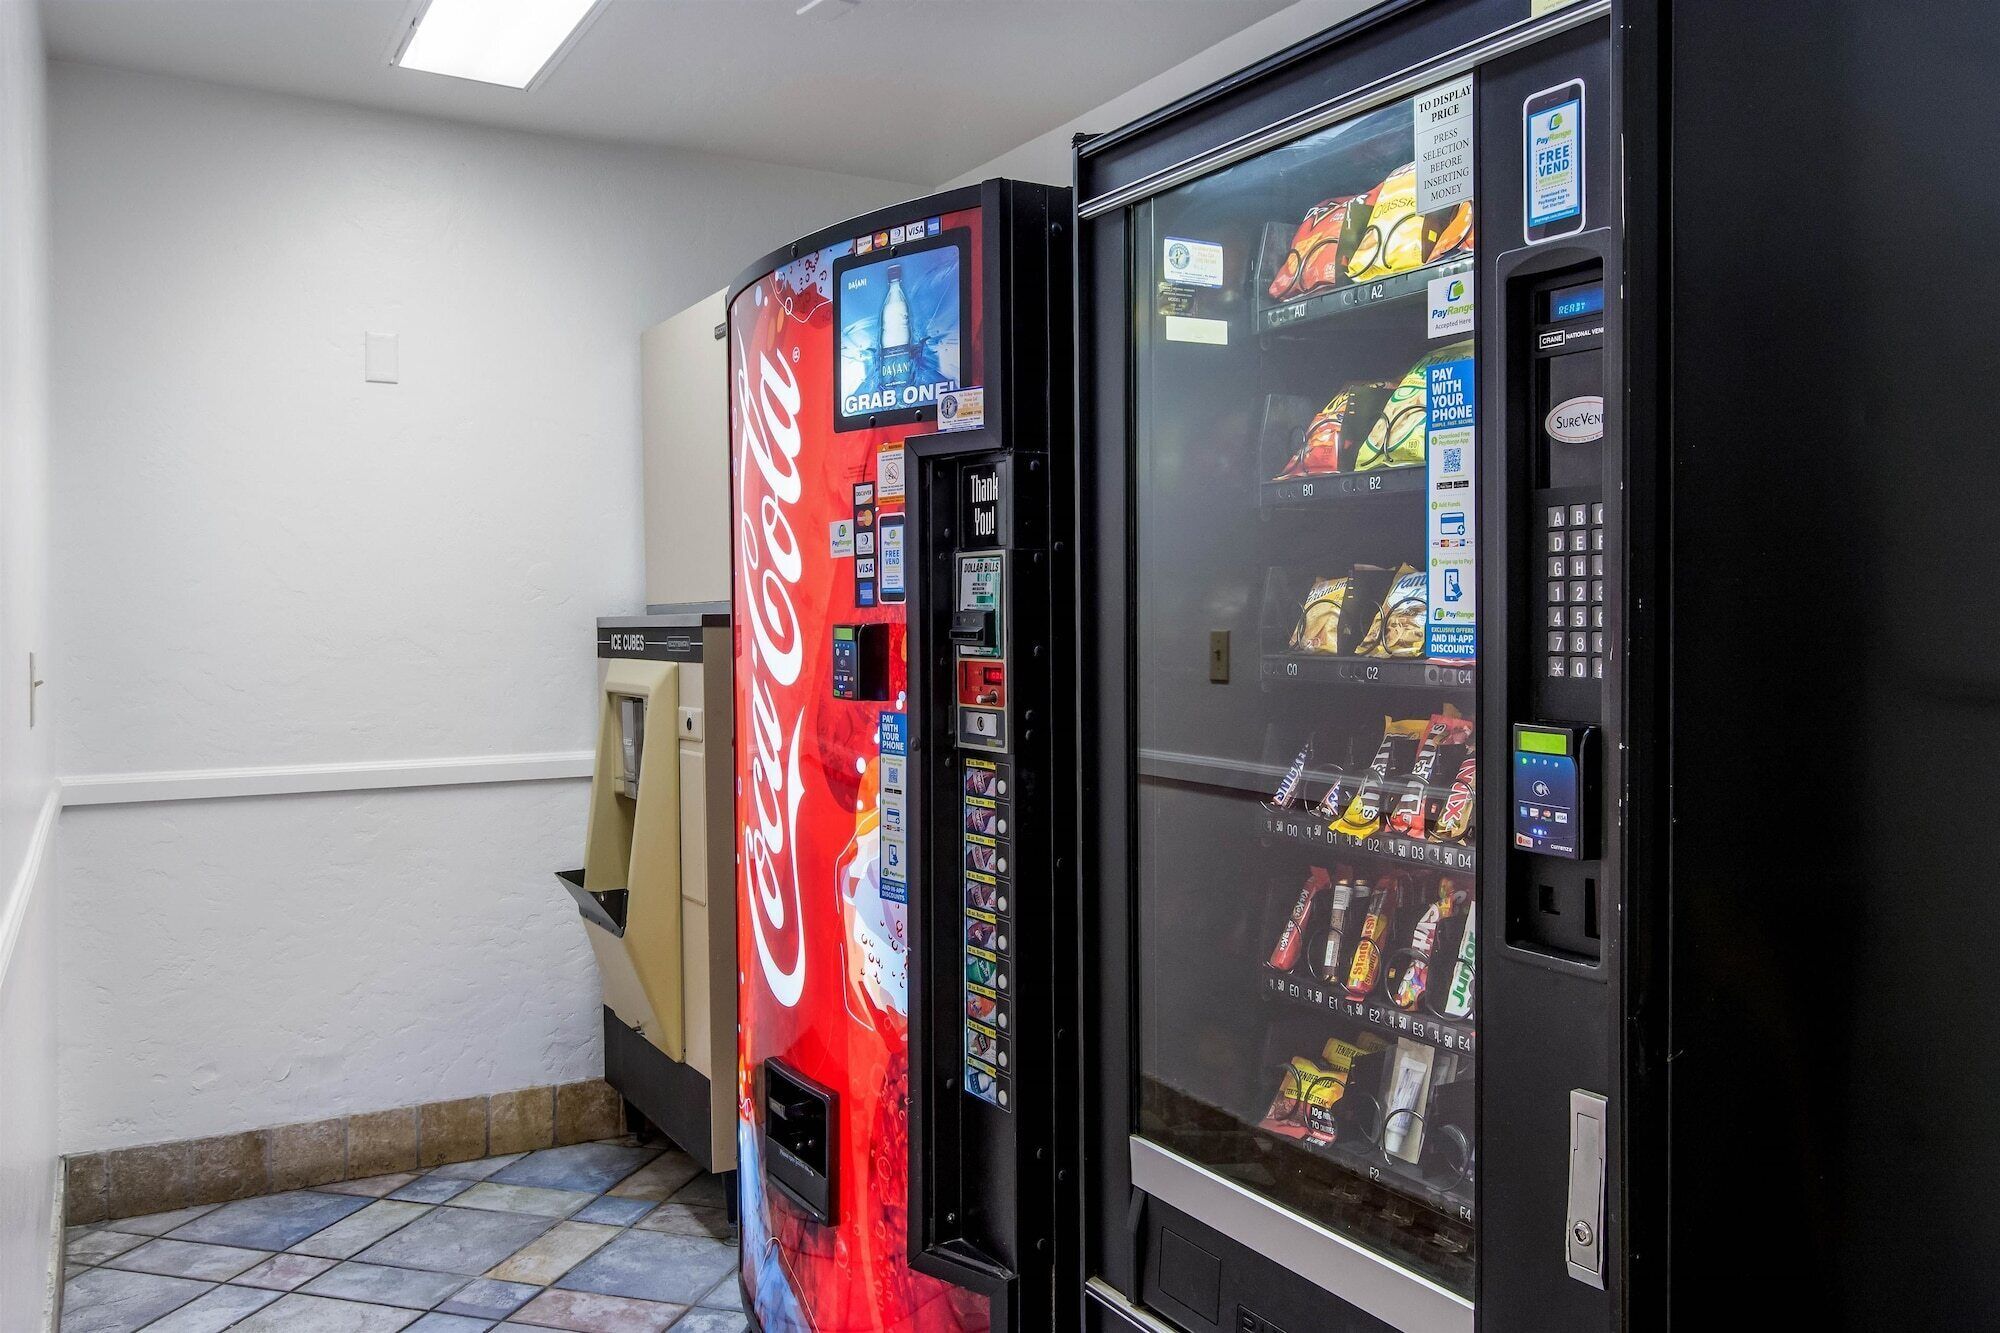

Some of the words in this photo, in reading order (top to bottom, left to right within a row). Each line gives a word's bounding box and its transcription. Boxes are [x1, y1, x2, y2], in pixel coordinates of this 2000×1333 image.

[1419, 100, 1431, 113] TO
[1434, 85, 1472, 108] DISPLAY
[1431, 104, 1460, 123] PRICE
[1433, 128, 1458, 144] PRESS
[1536, 129, 1572, 145] PayRange
[1423, 138, 1470, 162] SELECTION
[1539, 145, 1569, 165] FREE
[1430, 155, 1463, 174] BEFORE
[1539, 159, 1569, 177] VEND
[1424, 167, 1469, 190] INSERTING
[1431, 183, 1463, 201] MONEY
[908, 226, 924, 236] VISA
[1371, 284, 1384, 300] A2
[1294, 304, 1305, 318] A0
[1432, 303, 1474, 319] PayRange
[1435, 319, 1459, 330] Accepted
[1542, 335, 1562, 344] CRANE
[1566, 330, 1591, 339] NATIONAL
[1432, 367, 1453, 382] PAY
[1432, 379, 1462, 396] WITH
[845, 389, 896, 413] GRAB
[1432, 392, 1464, 409] YOUR
[1432, 404, 1472, 422] PHONE
[971, 472, 998, 503] Thank
[1303, 484, 1313, 496] B0
[1369, 477, 1381, 490] B2
[974, 506, 995, 536] You!
[1554, 512, 1562, 526] A
[1576, 511, 1584, 524] B
[1554, 537, 1562, 551] D
[1576, 536, 1584, 550] E
[885, 549, 900, 558] FREE
[858, 563, 873, 573] VISA
[964, 563, 983, 573] DOLLAR
[984, 562, 999, 573] BILLS
[1554, 562, 1562, 576] G
[1576, 561, 1584, 575] H
[1555, 587, 1560, 601] 1
[1576, 587, 1583, 600] 2
[1446, 610, 1474, 619] PayRange
[1554, 612, 1561, 625] 4
[1576, 612, 1583, 625] 5
[611, 634, 621, 650] ICE
[623, 634, 645, 651] CUBES
[1431, 634, 1447, 642] AND
[1448, 634, 1474, 643] IN-APP
[1556, 637, 1562, 650] 7
[1577, 637, 1584, 650] 8
[1431, 644, 1474, 654] DISCOUNTS
[1287, 663, 1298, 676] C0
[1366, 666, 1379, 680] C2
[1576, 663, 1583, 676] 0
[1458, 670, 1472, 684] C4
[882, 714, 894, 723] PAY
[882, 723, 898, 732] WITH
[882, 732, 900, 741] YOUR
[882, 740, 904, 751] PHONE
[1287, 824, 1298, 837] D0
[1327, 831, 1337, 844] D1
[1368, 838, 1380, 852] D2
[1411, 846, 1424, 860] D3
[1458, 854, 1471, 869] D4
[1452, 931, 1475, 1008] Junior
[1289, 984, 1299, 998] E0
[1329, 996, 1338, 1010] E1
[1369, 1008, 1380, 1024] E2
[1412, 1021, 1424, 1038] E3
[1458, 1035, 1470, 1051] E4
[1312, 1107, 1323, 1119] 10g
[1311, 1120, 1320, 1130] 70
[1369, 1167, 1380, 1182] F2
[1459, 1206, 1471, 1221] F4
